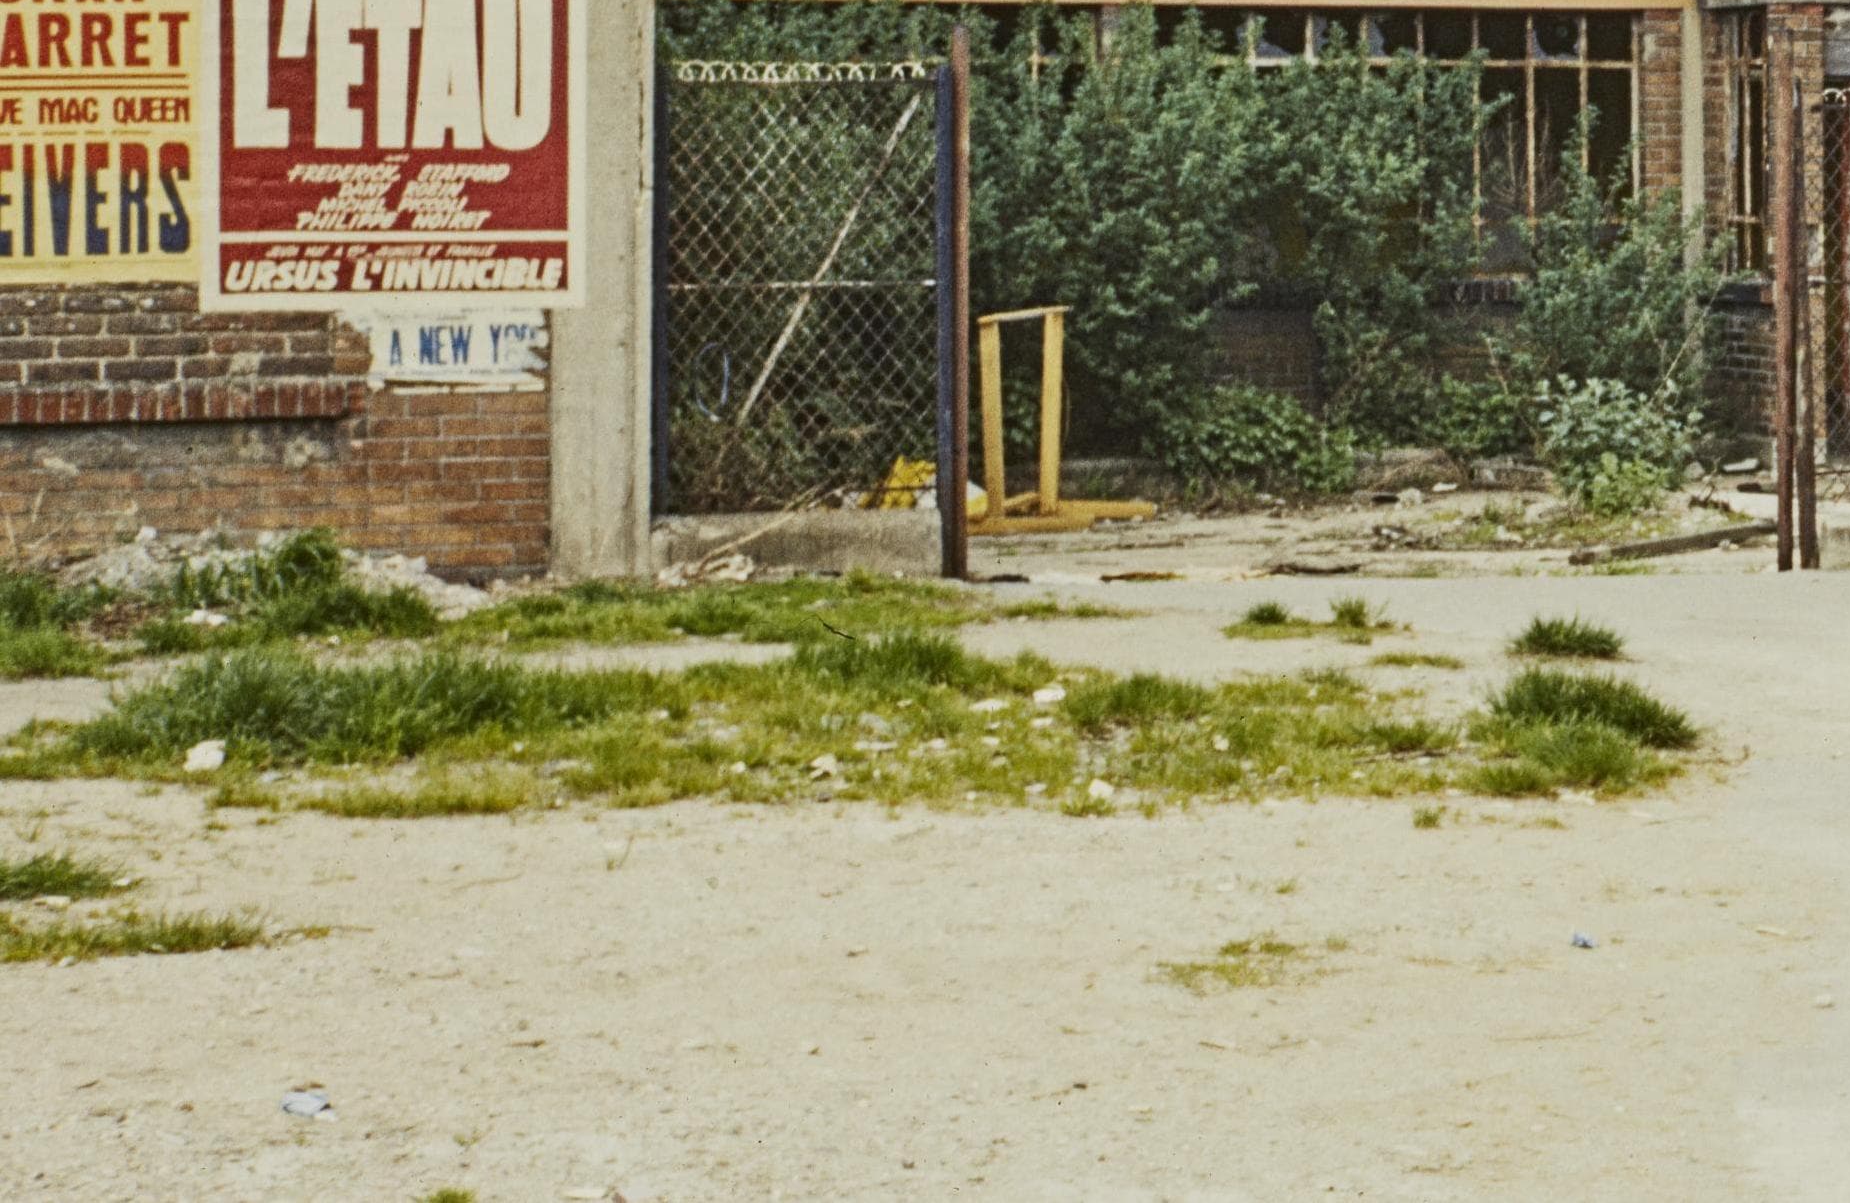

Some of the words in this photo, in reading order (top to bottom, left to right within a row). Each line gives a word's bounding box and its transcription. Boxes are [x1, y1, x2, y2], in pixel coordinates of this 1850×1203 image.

[0, 12, 190, 67] ARRET
[39, 98, 99, 124] MAC
[113, 97, 190, 125] QUEEN
[411, 210, 492, 230] NOIRET
[224, 260, 340, 292] URSUS
[351, 257, 563, 291] L'INVINCIBLE
[390, 329, 402, 365] A
[419, 325, 472, 365] NEW
